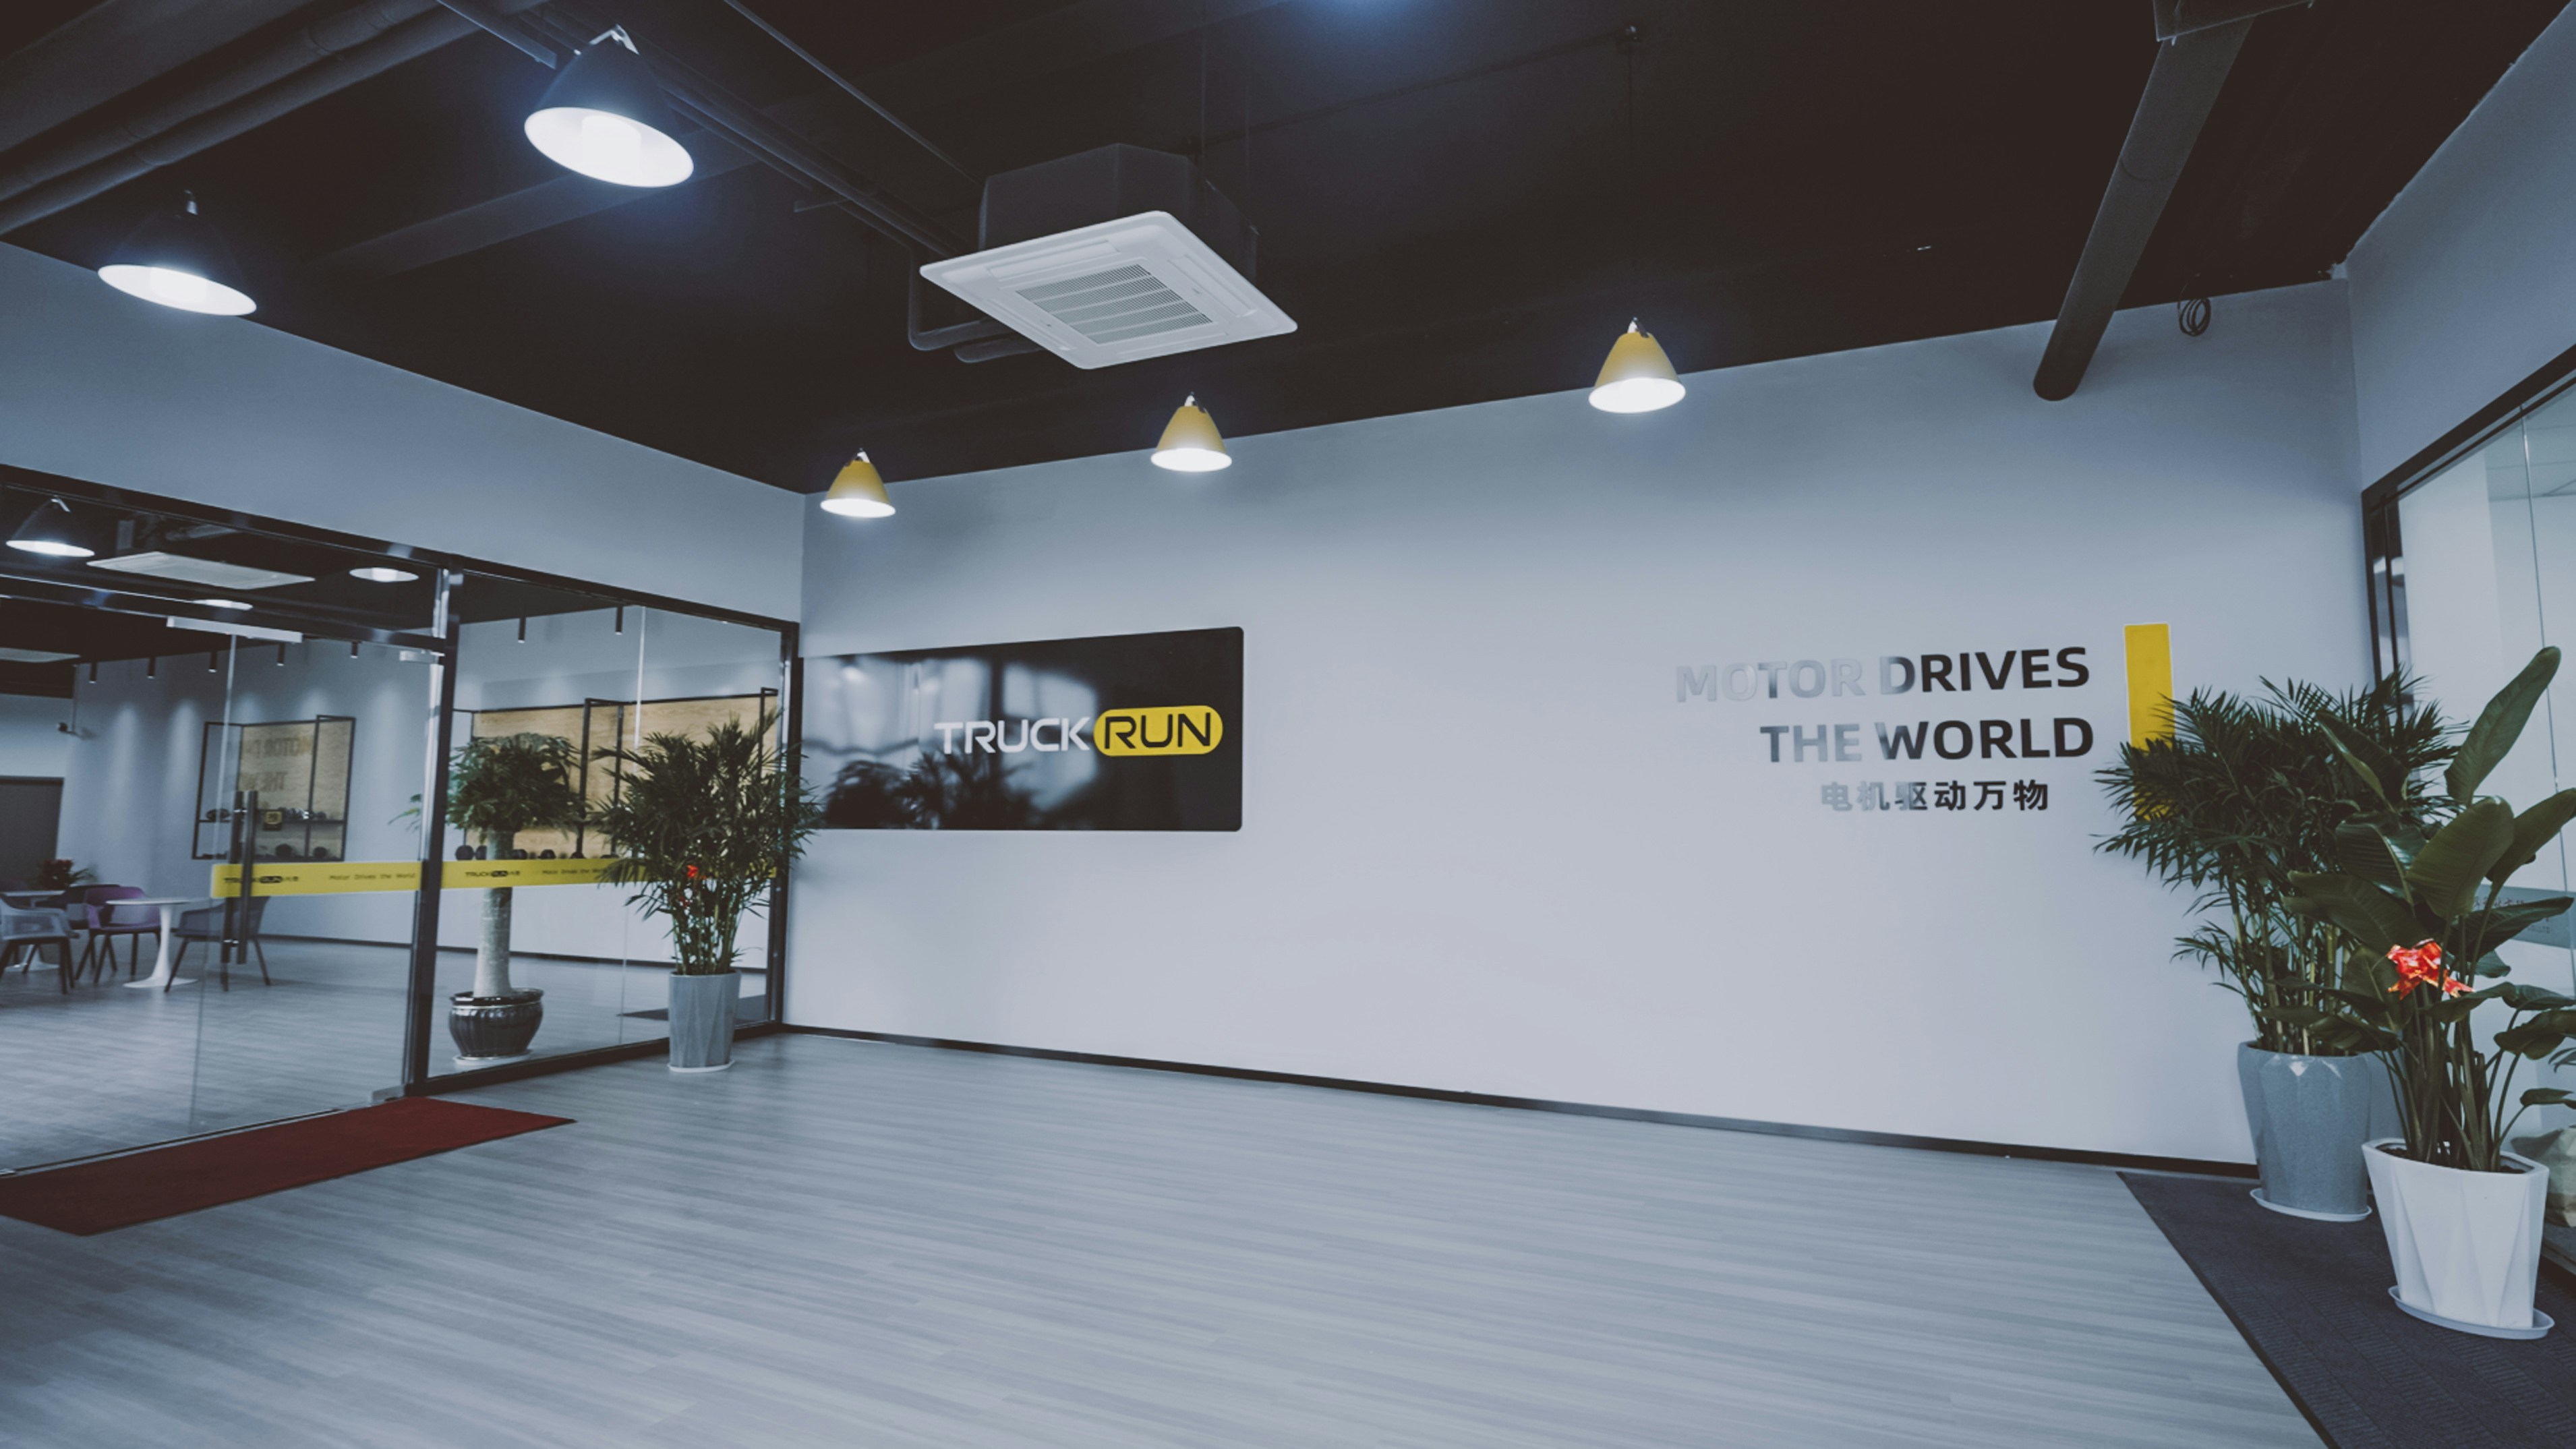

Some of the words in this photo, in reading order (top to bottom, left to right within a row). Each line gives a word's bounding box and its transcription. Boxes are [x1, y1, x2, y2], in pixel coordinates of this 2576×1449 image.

[1676, 657, 1865, 703] MOTOR
[1879, 647, 2090, 694] DRIVES
[934, 716, 1091, 755] TRUCK
[1105, 712, 1211, 749] RUN
[1759, 723, 1862, 763] THE
[1874, 717, 2094, 760] WORLD
[1820, 779, 2049, 812] 电机驱动万物
